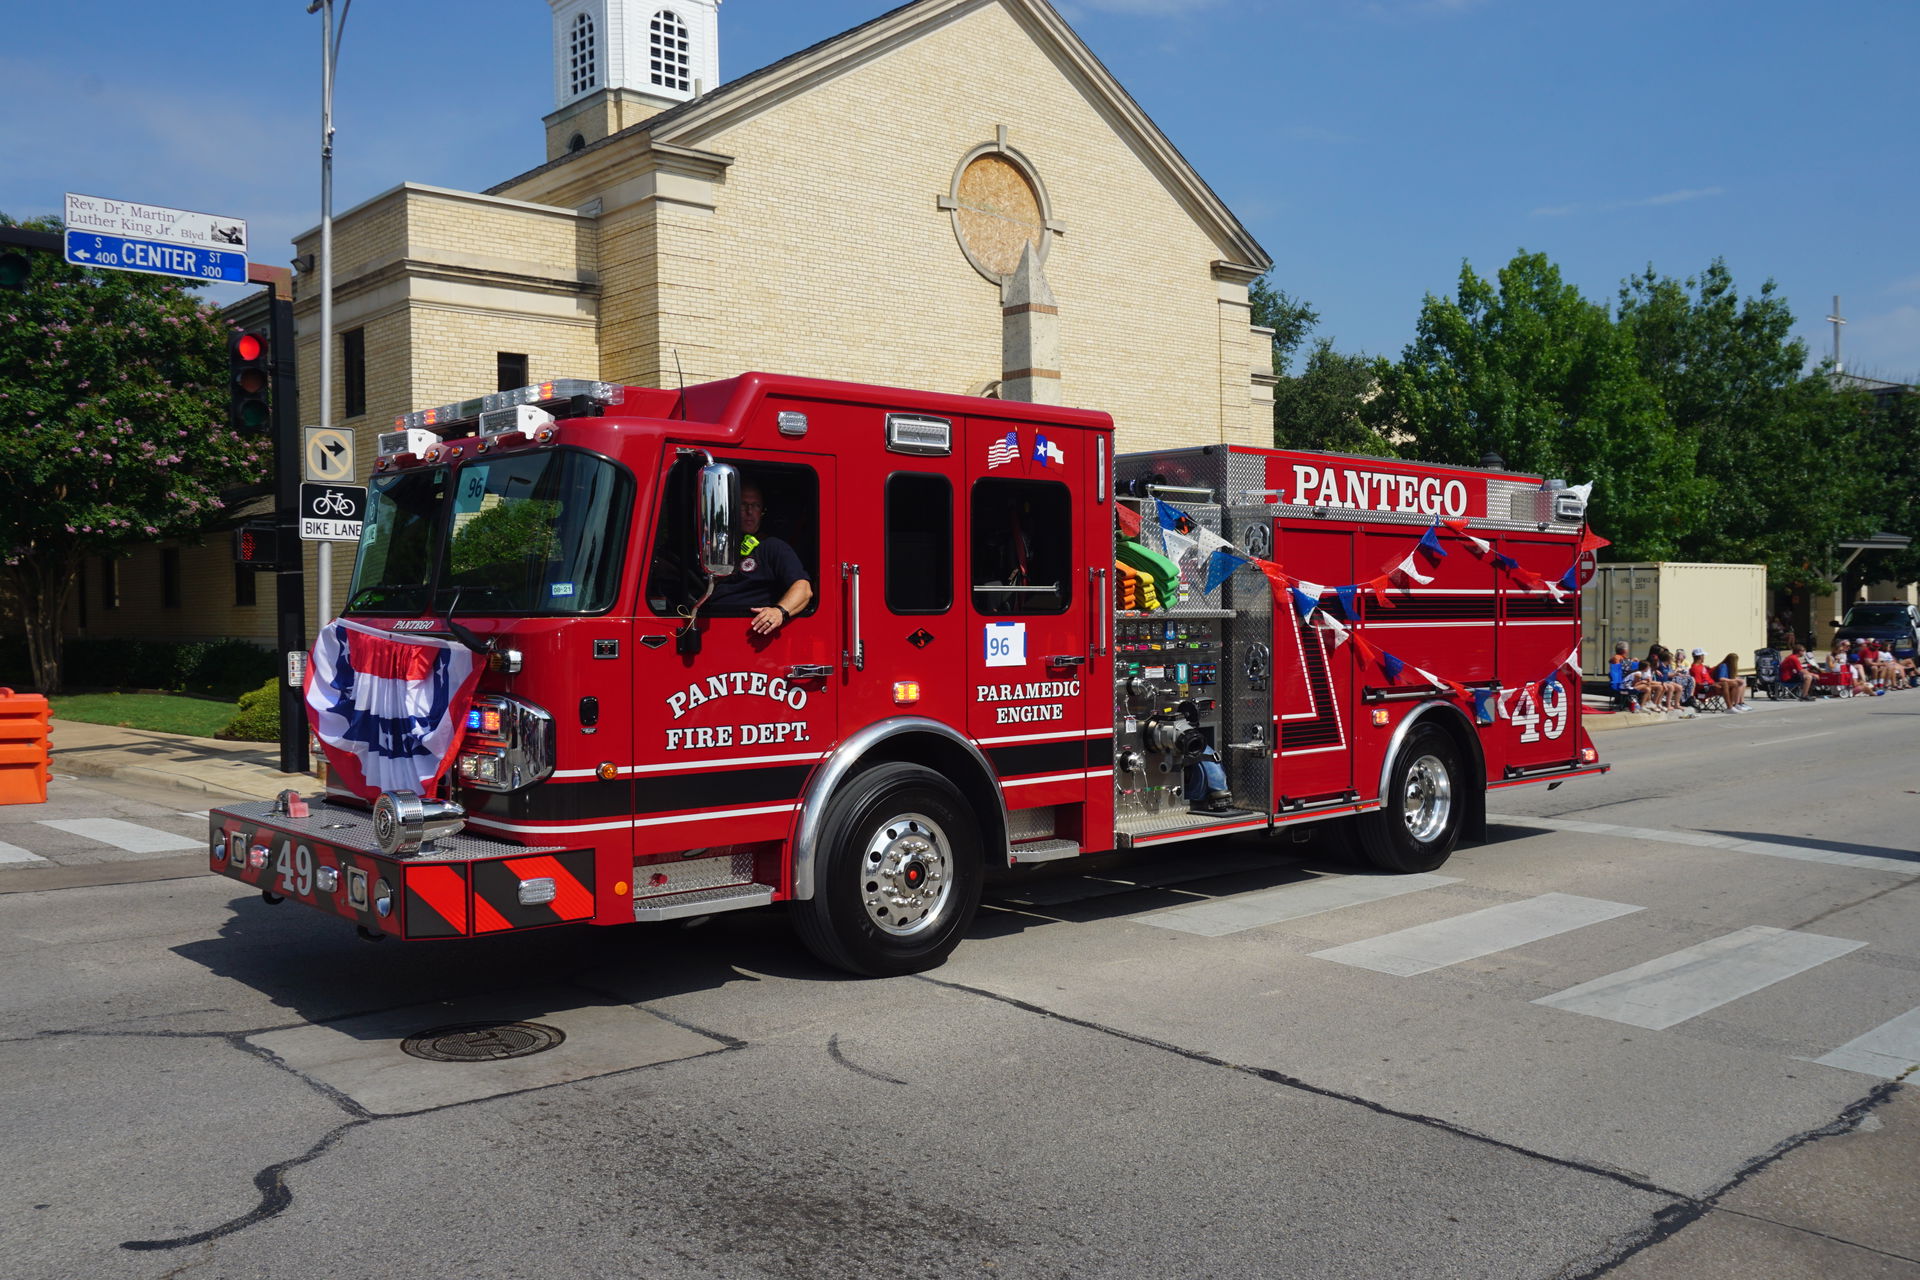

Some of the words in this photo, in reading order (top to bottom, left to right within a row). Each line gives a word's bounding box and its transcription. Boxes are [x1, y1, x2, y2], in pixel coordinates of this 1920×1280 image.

[69, 196, 98, 212] Rev.
[104, 201, 125, 216] Dr.
[131, 205, 175, 223] Martin
[70, 211, 115, 228] Luther
[121, 218, 153, 236] King
[156, 223, 174, 236] Jr.
[181, 228, 207, 241] Blvd.
[95, 237, 102, 248] S
[122, 242, 196, 273] CENTER
[209, 253, 221, 264] ST
[95, 252, 117, 265] 400
[201, 265, 222, 279] 300
[468, 477, 483, 498] 96
[1292, 464, 1467, 517] PANTEGO
[305, 521, 329, 535] BIKE
[334, 523, 362, 537] LANE
[393, 620, 435, 630] PANTEGO
[990, 637, 1010, 656] 96
[666, 671, 808, 720] PANTEGO
[977, 680, 1080, 702] PARAMEDIC
[996, 704, 1063, 724] ENGINE
[1511, 680, 1568, 743] 49
[665, 725, 733, 750] FIRE
[740, 721, 810, 746] DEPT.
[275, 839, 313, 897] 49
